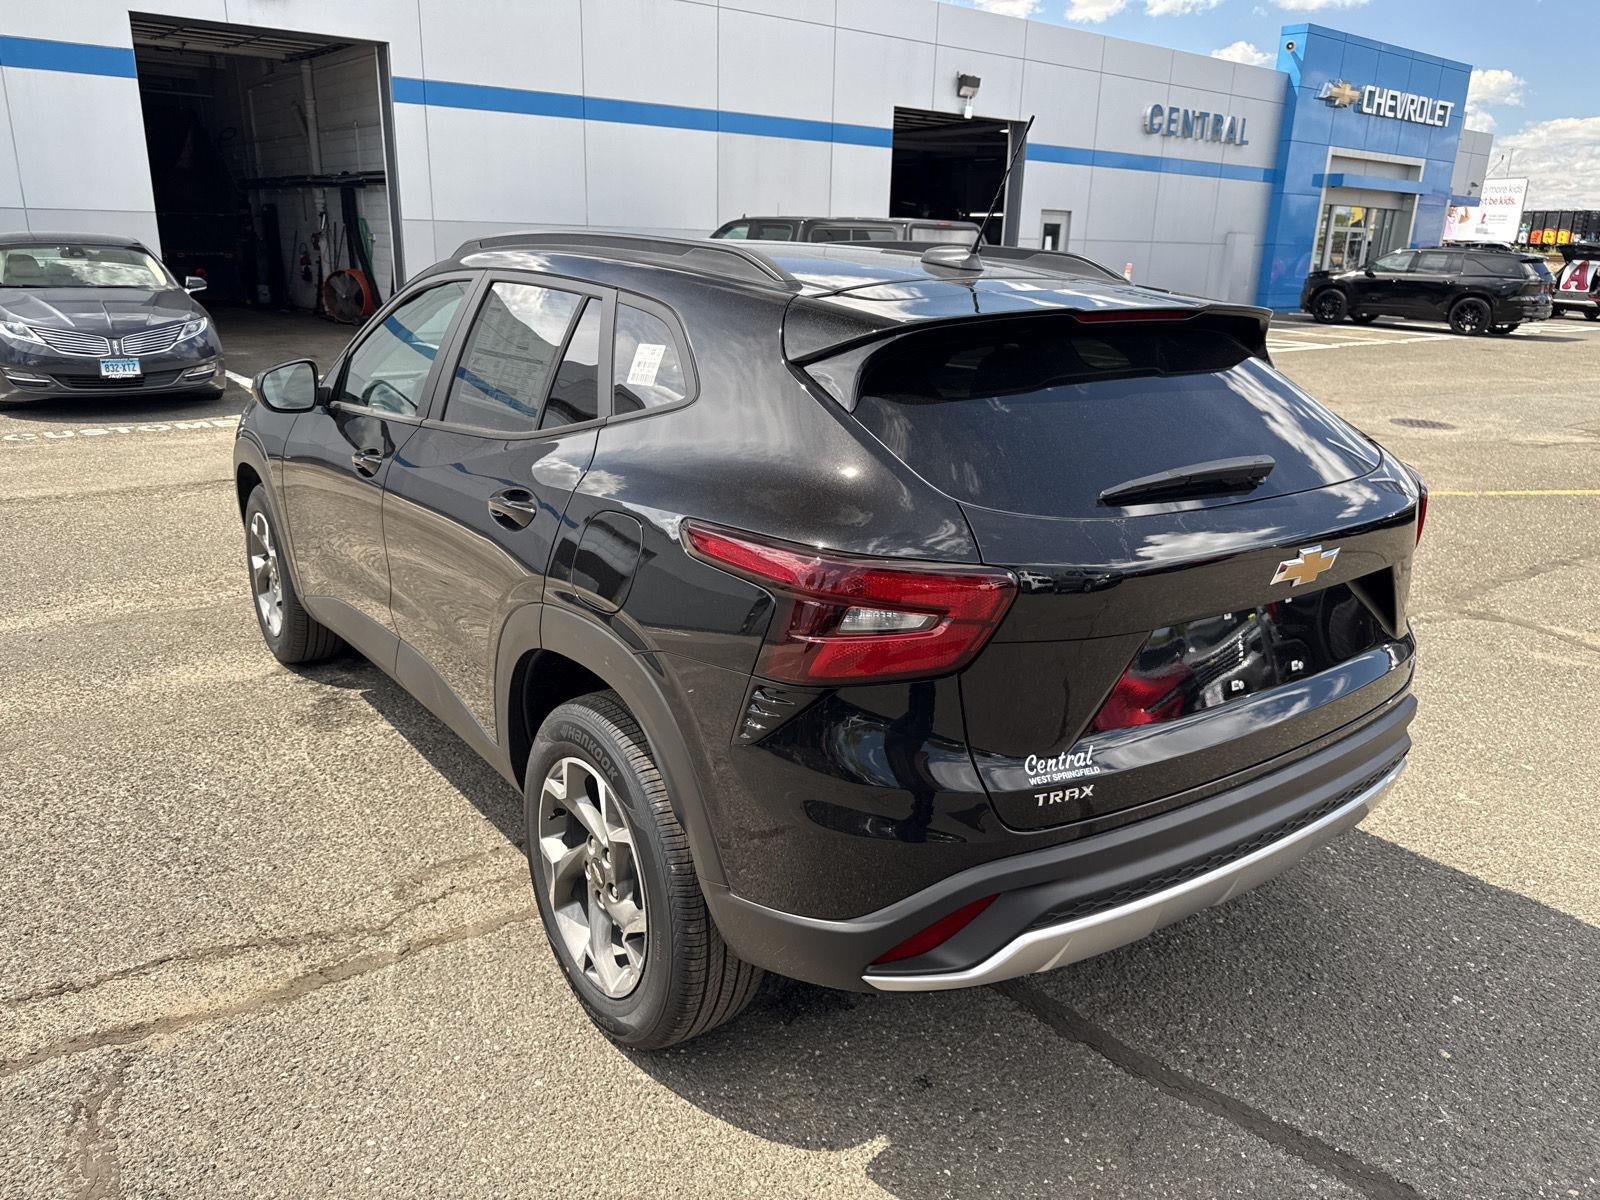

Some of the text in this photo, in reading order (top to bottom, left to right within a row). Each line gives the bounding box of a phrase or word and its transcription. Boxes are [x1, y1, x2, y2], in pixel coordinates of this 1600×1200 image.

[1362, 84, 1455, 128] CHEVROLET
[1144, 104, 1249, 145] CENTRAL
[1562, 260, 1589, 290] A
[3, 418, 240, 441] CUSTOME
[1024, 745, 1093, 775] Central
[1029, 766, 1100, 785] WEST SPRINGFIELD
[1034, 784, 1095, 807] TRAX
